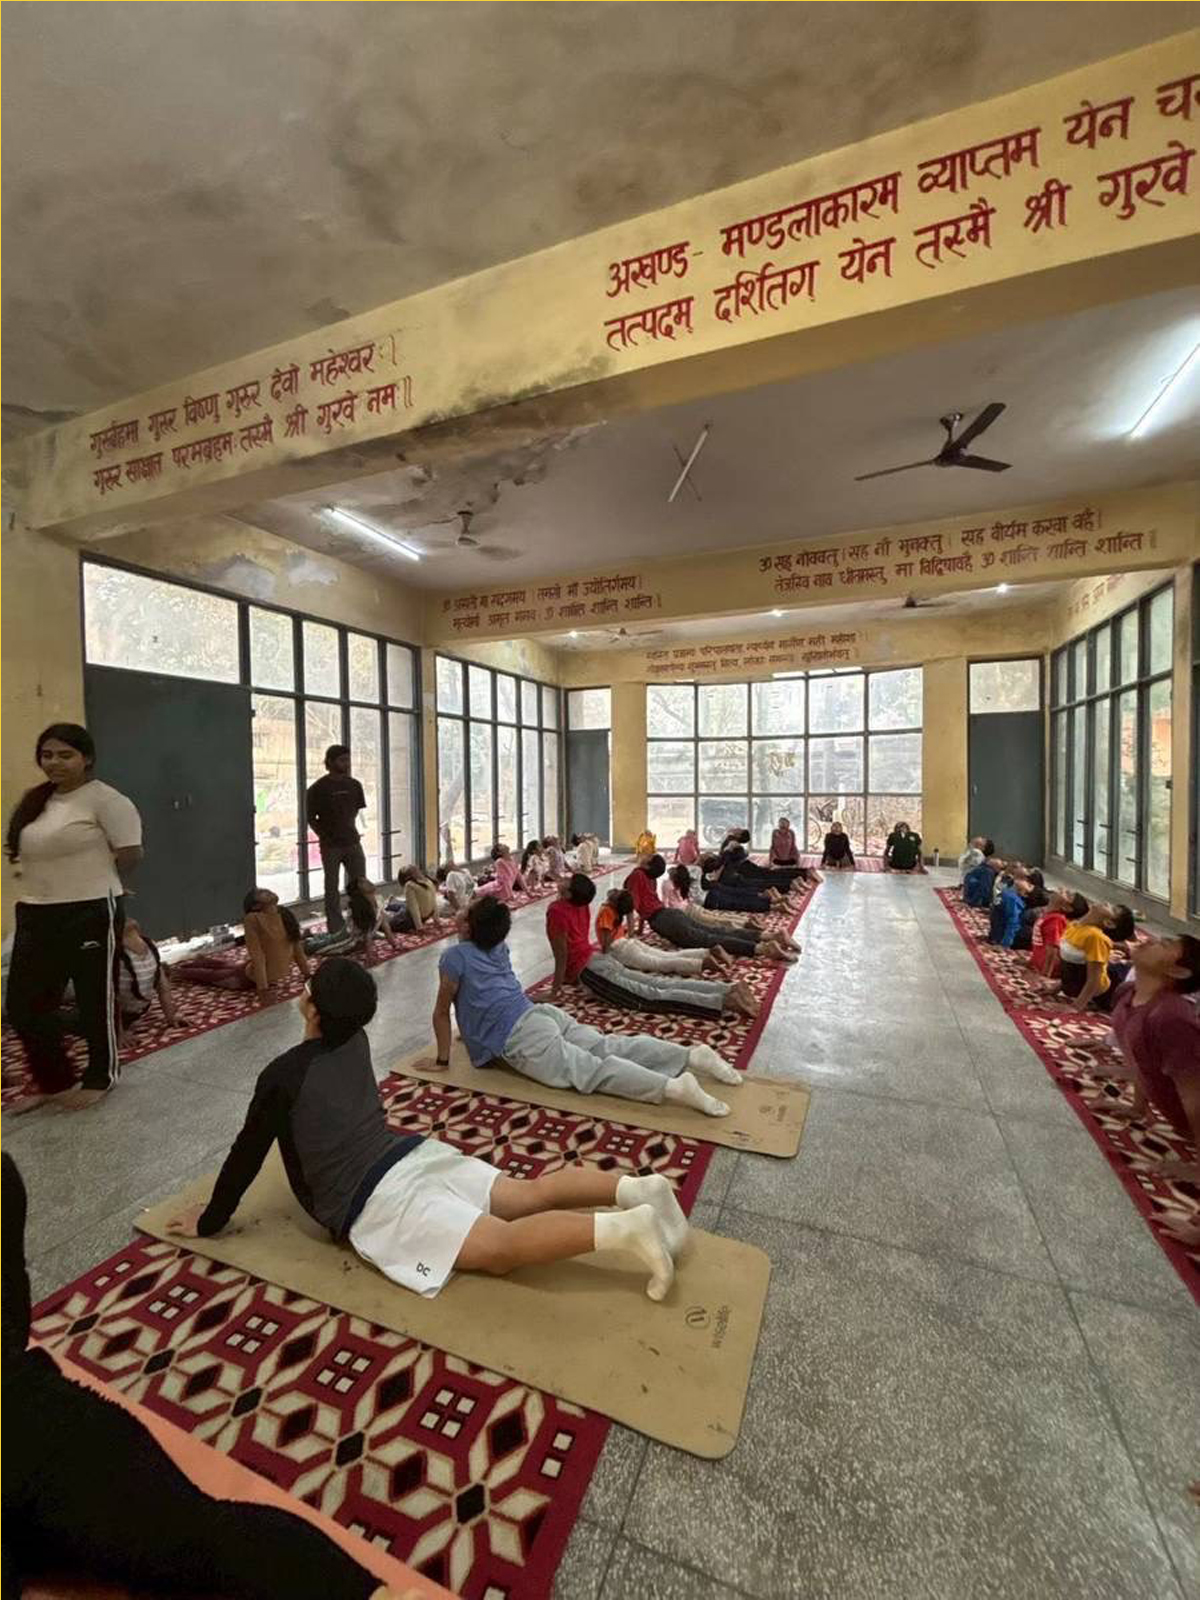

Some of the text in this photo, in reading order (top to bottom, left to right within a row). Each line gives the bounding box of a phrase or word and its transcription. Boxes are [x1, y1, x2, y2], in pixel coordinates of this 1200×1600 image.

[721, 171, 902, 258] मण्डलाकारम
[918, 127, 1041, 196] व्याप्तम
[1064, 96, 1134, 150] येन
[839, 237, 896, 284] येन
[915, 197, 997, 269] तस्मै
[1024, 178, 1072, 232] श्री
[1098, 140, 1197, 220] गुरवे
[239, 412, 275, 452] तस्मै
[284, 405, 309, 438] श्री
[316, 389, 358, 435] गुरवे
[1094, 529, 1145, 555] शान्ति
